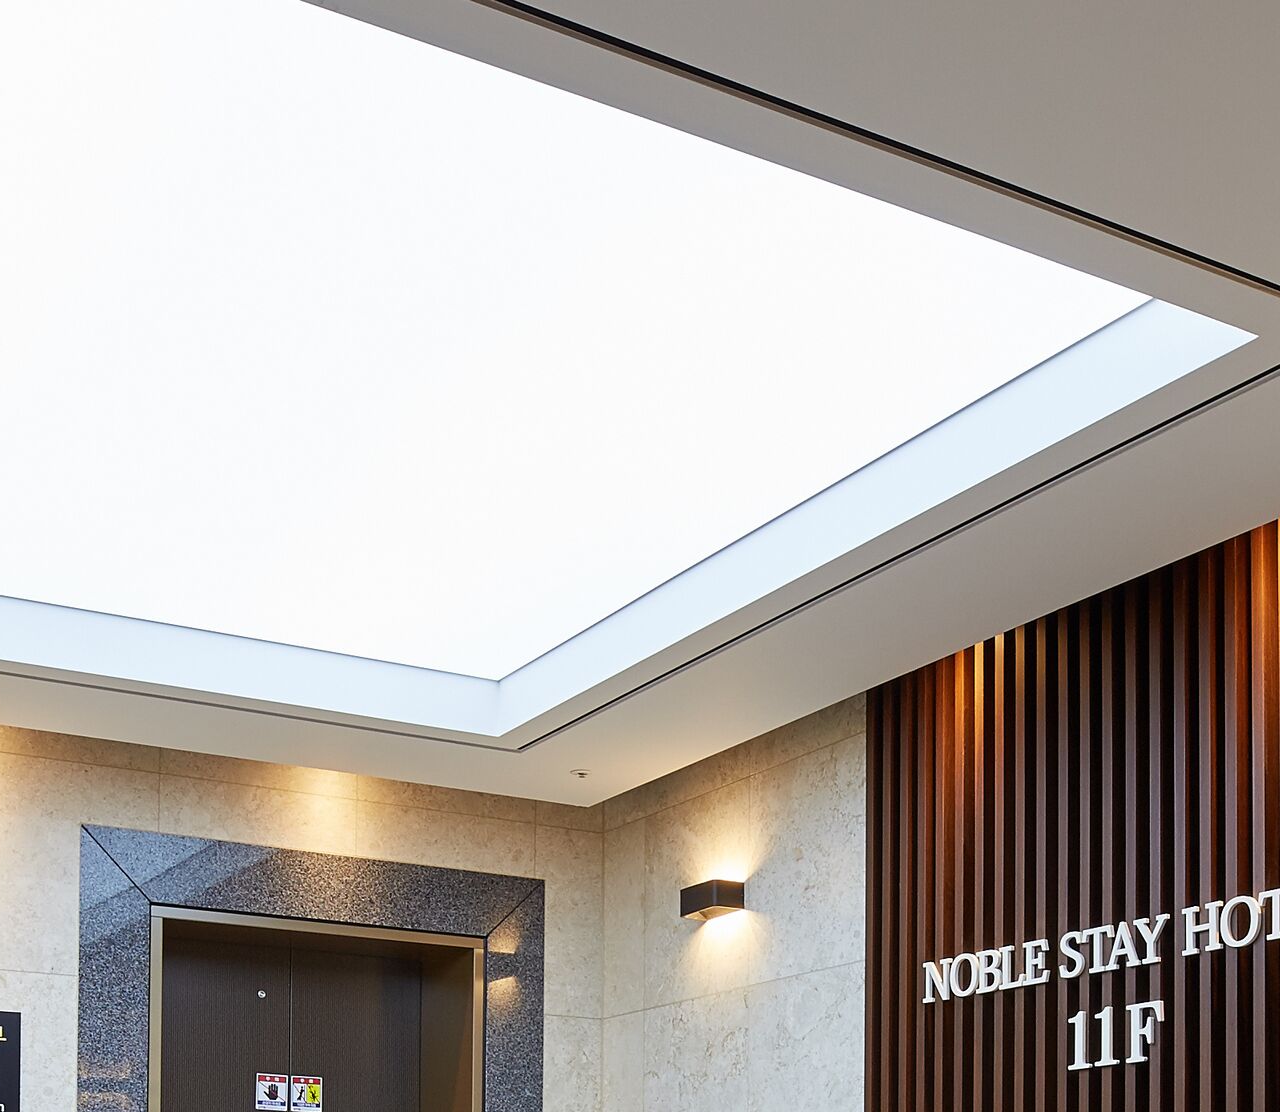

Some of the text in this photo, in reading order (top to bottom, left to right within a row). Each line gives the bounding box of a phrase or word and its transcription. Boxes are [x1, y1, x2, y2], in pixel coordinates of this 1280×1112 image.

[922, 939, 1051, 1003] NOBLE
[1058, 913, 1171, 979] STAY
[1067, 1000, 1165, 1071] 11F
